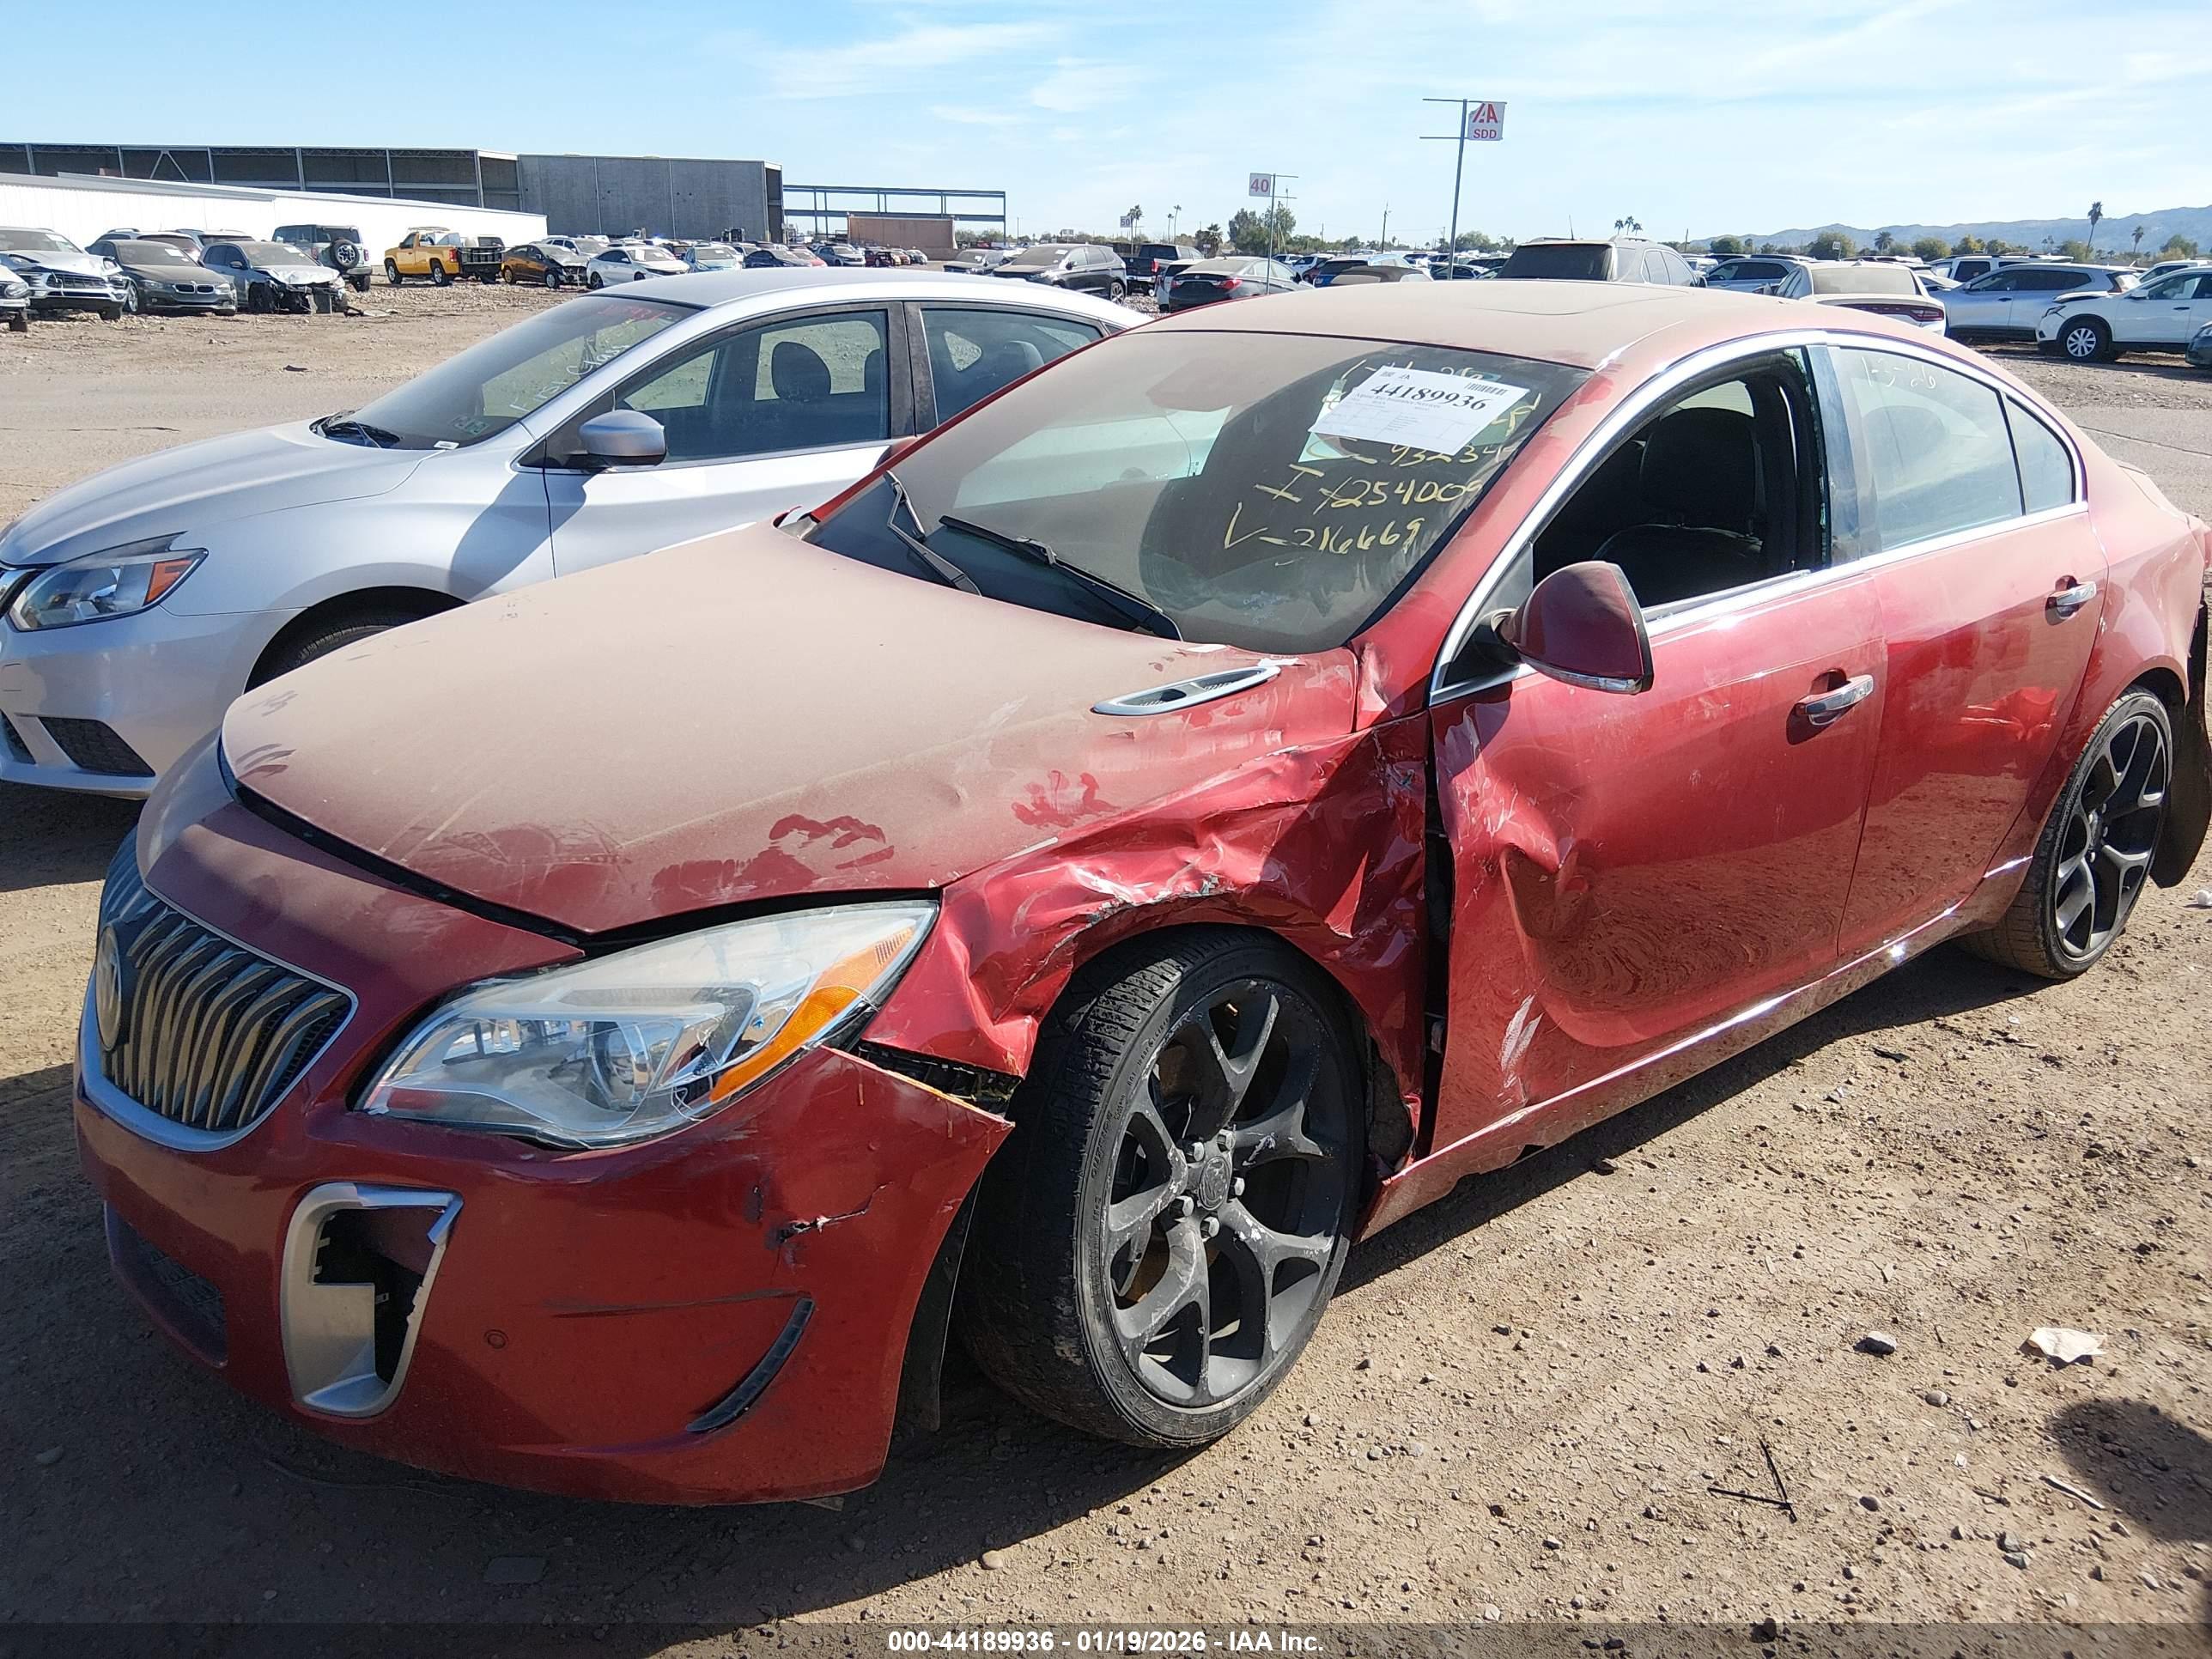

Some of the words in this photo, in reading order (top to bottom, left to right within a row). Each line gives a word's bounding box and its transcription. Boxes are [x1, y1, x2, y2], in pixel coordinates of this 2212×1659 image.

[1473, 129, 1497, 139] SDD
[1250, 178, 1269, 193] 40
[1370, 383, 1492, 411] 44189936
